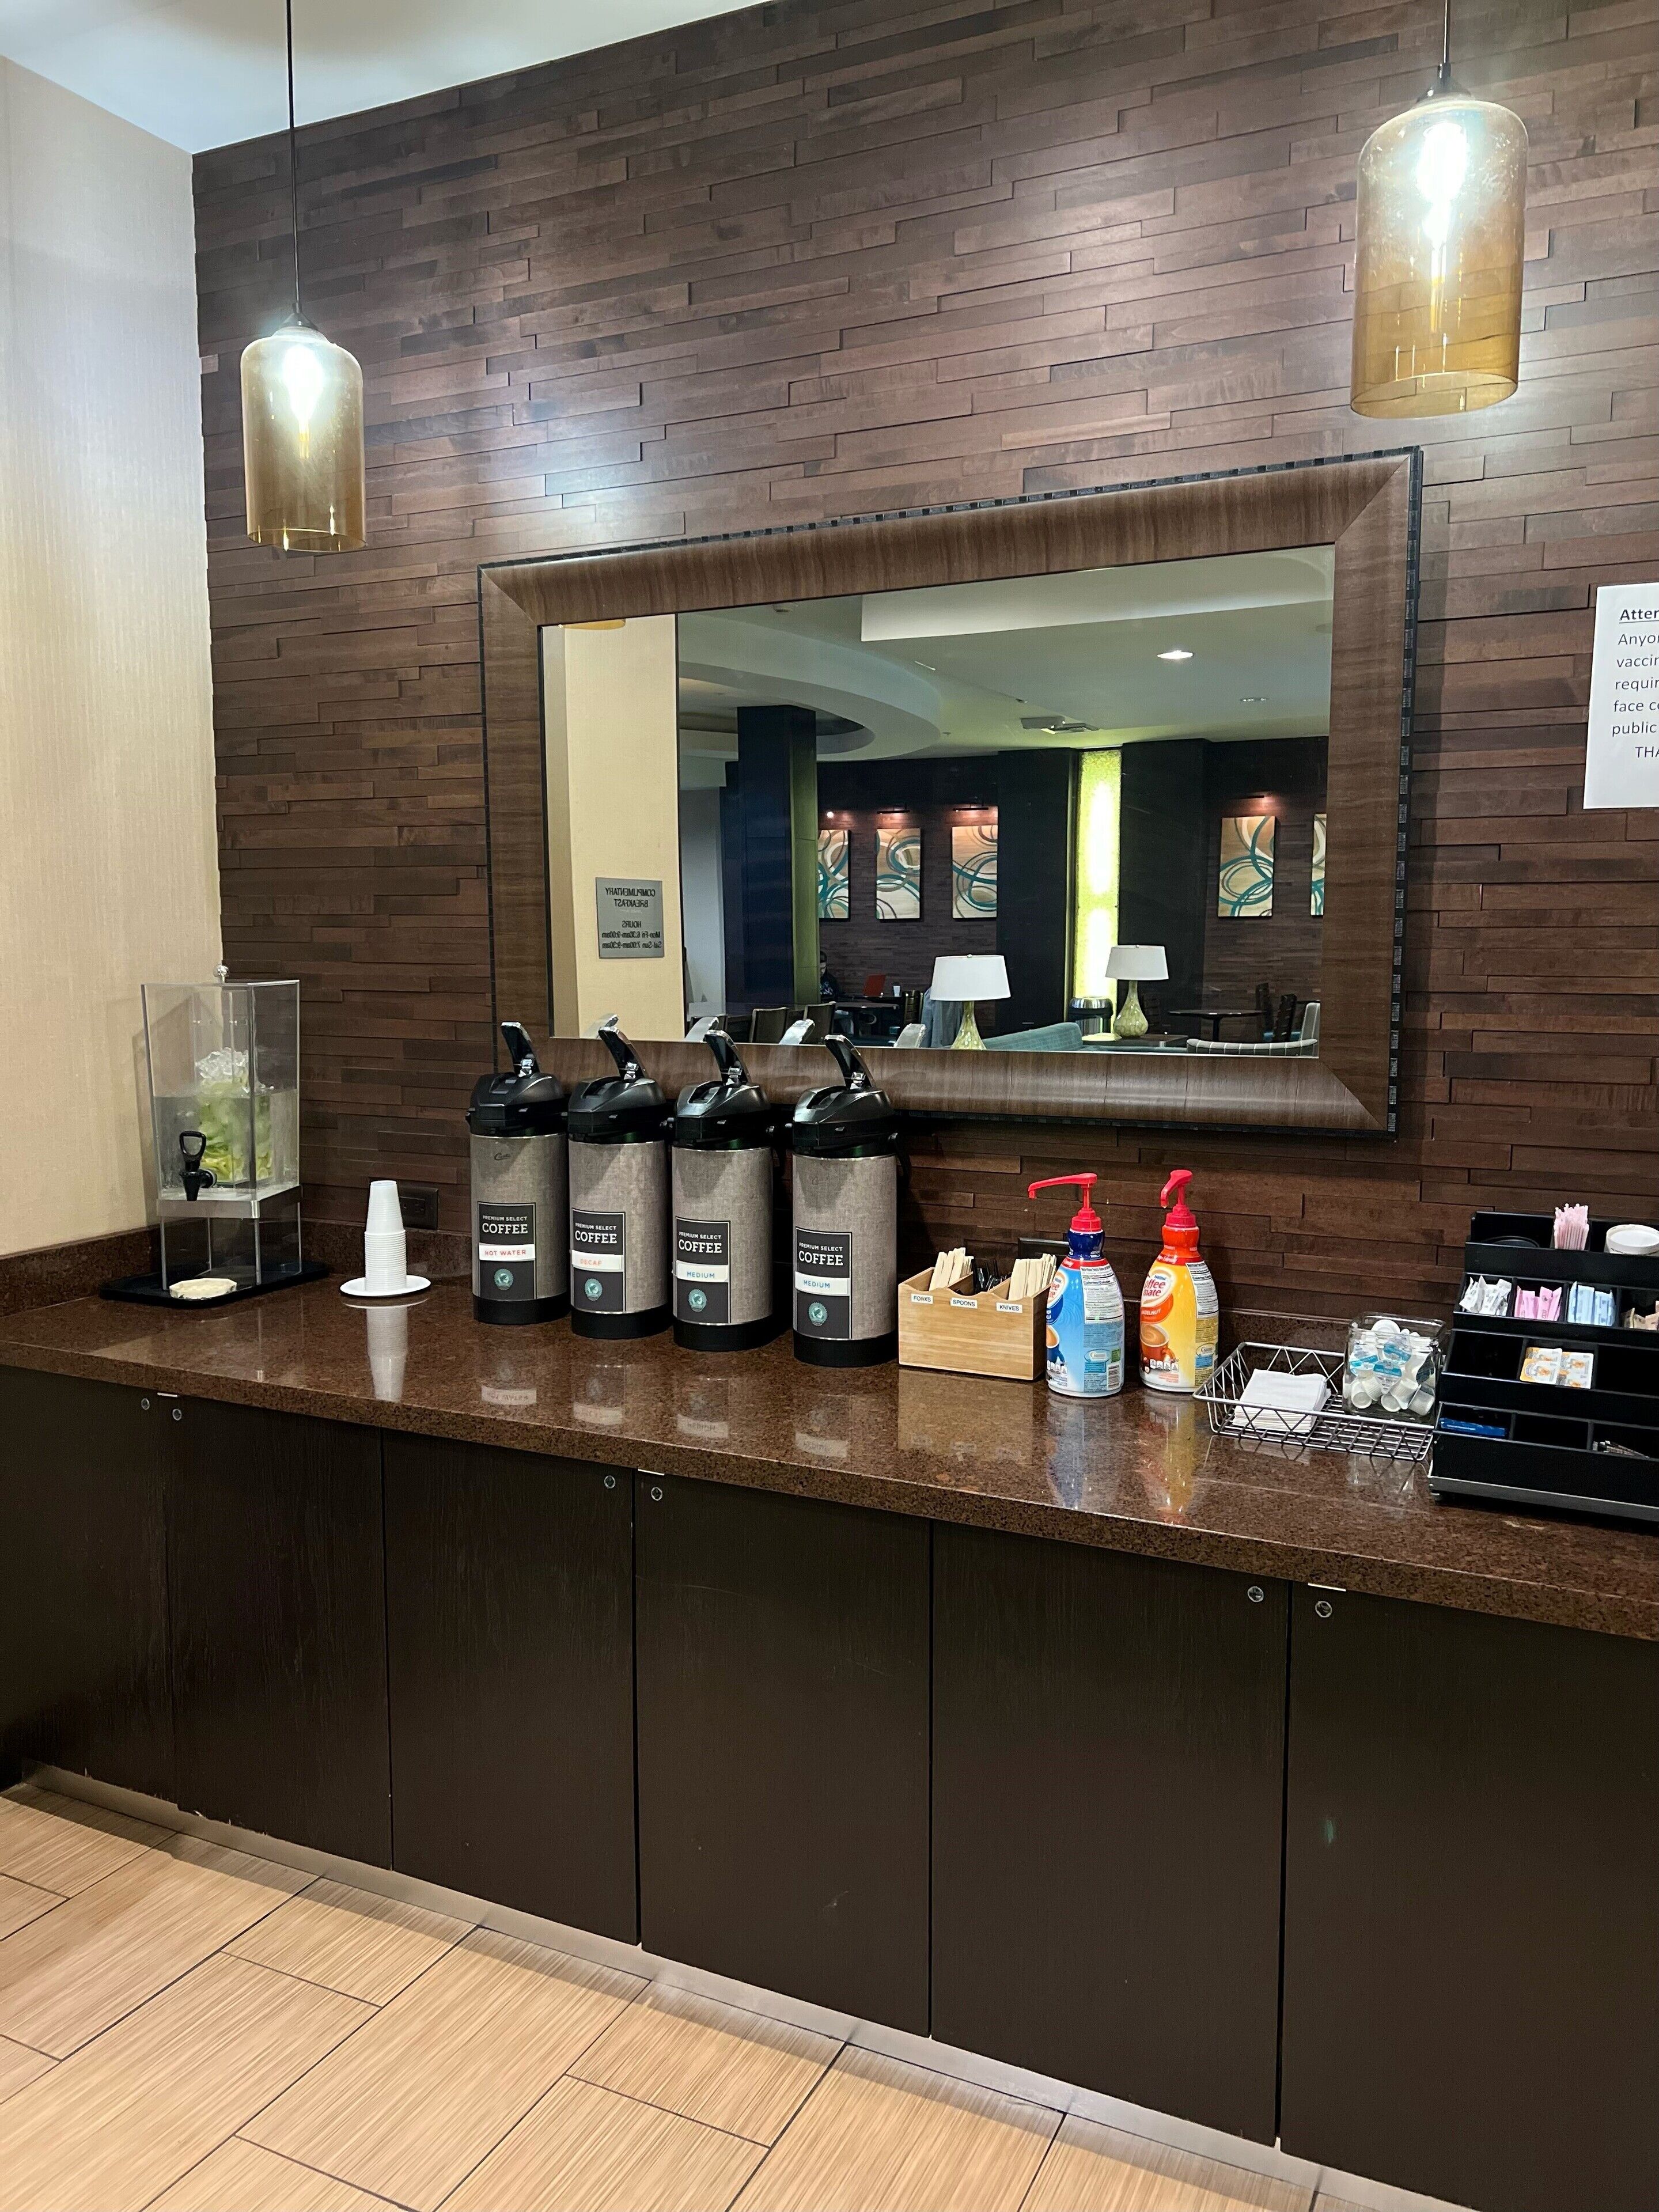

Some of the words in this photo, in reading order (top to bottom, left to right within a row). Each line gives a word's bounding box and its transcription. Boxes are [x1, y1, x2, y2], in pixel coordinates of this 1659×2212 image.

[1618, 634, 1659, 647] Anyo
[1613, 700, 1644, 713] face
[1612, 721, 1657, 737] public
[482, 1222, 528, 1234] COFFEE
[575, 1230, 618, 1244] COFFEE
[679, 1239, 722, 1253] COFFEE
[799, 1242, 819, 1251] PREMIUM
[798, 1250, 843, 1266] COFFEE
[803, 1279, 830, 1289] MEDIUM
[952, 1299, 975, 1307] SPOONS
